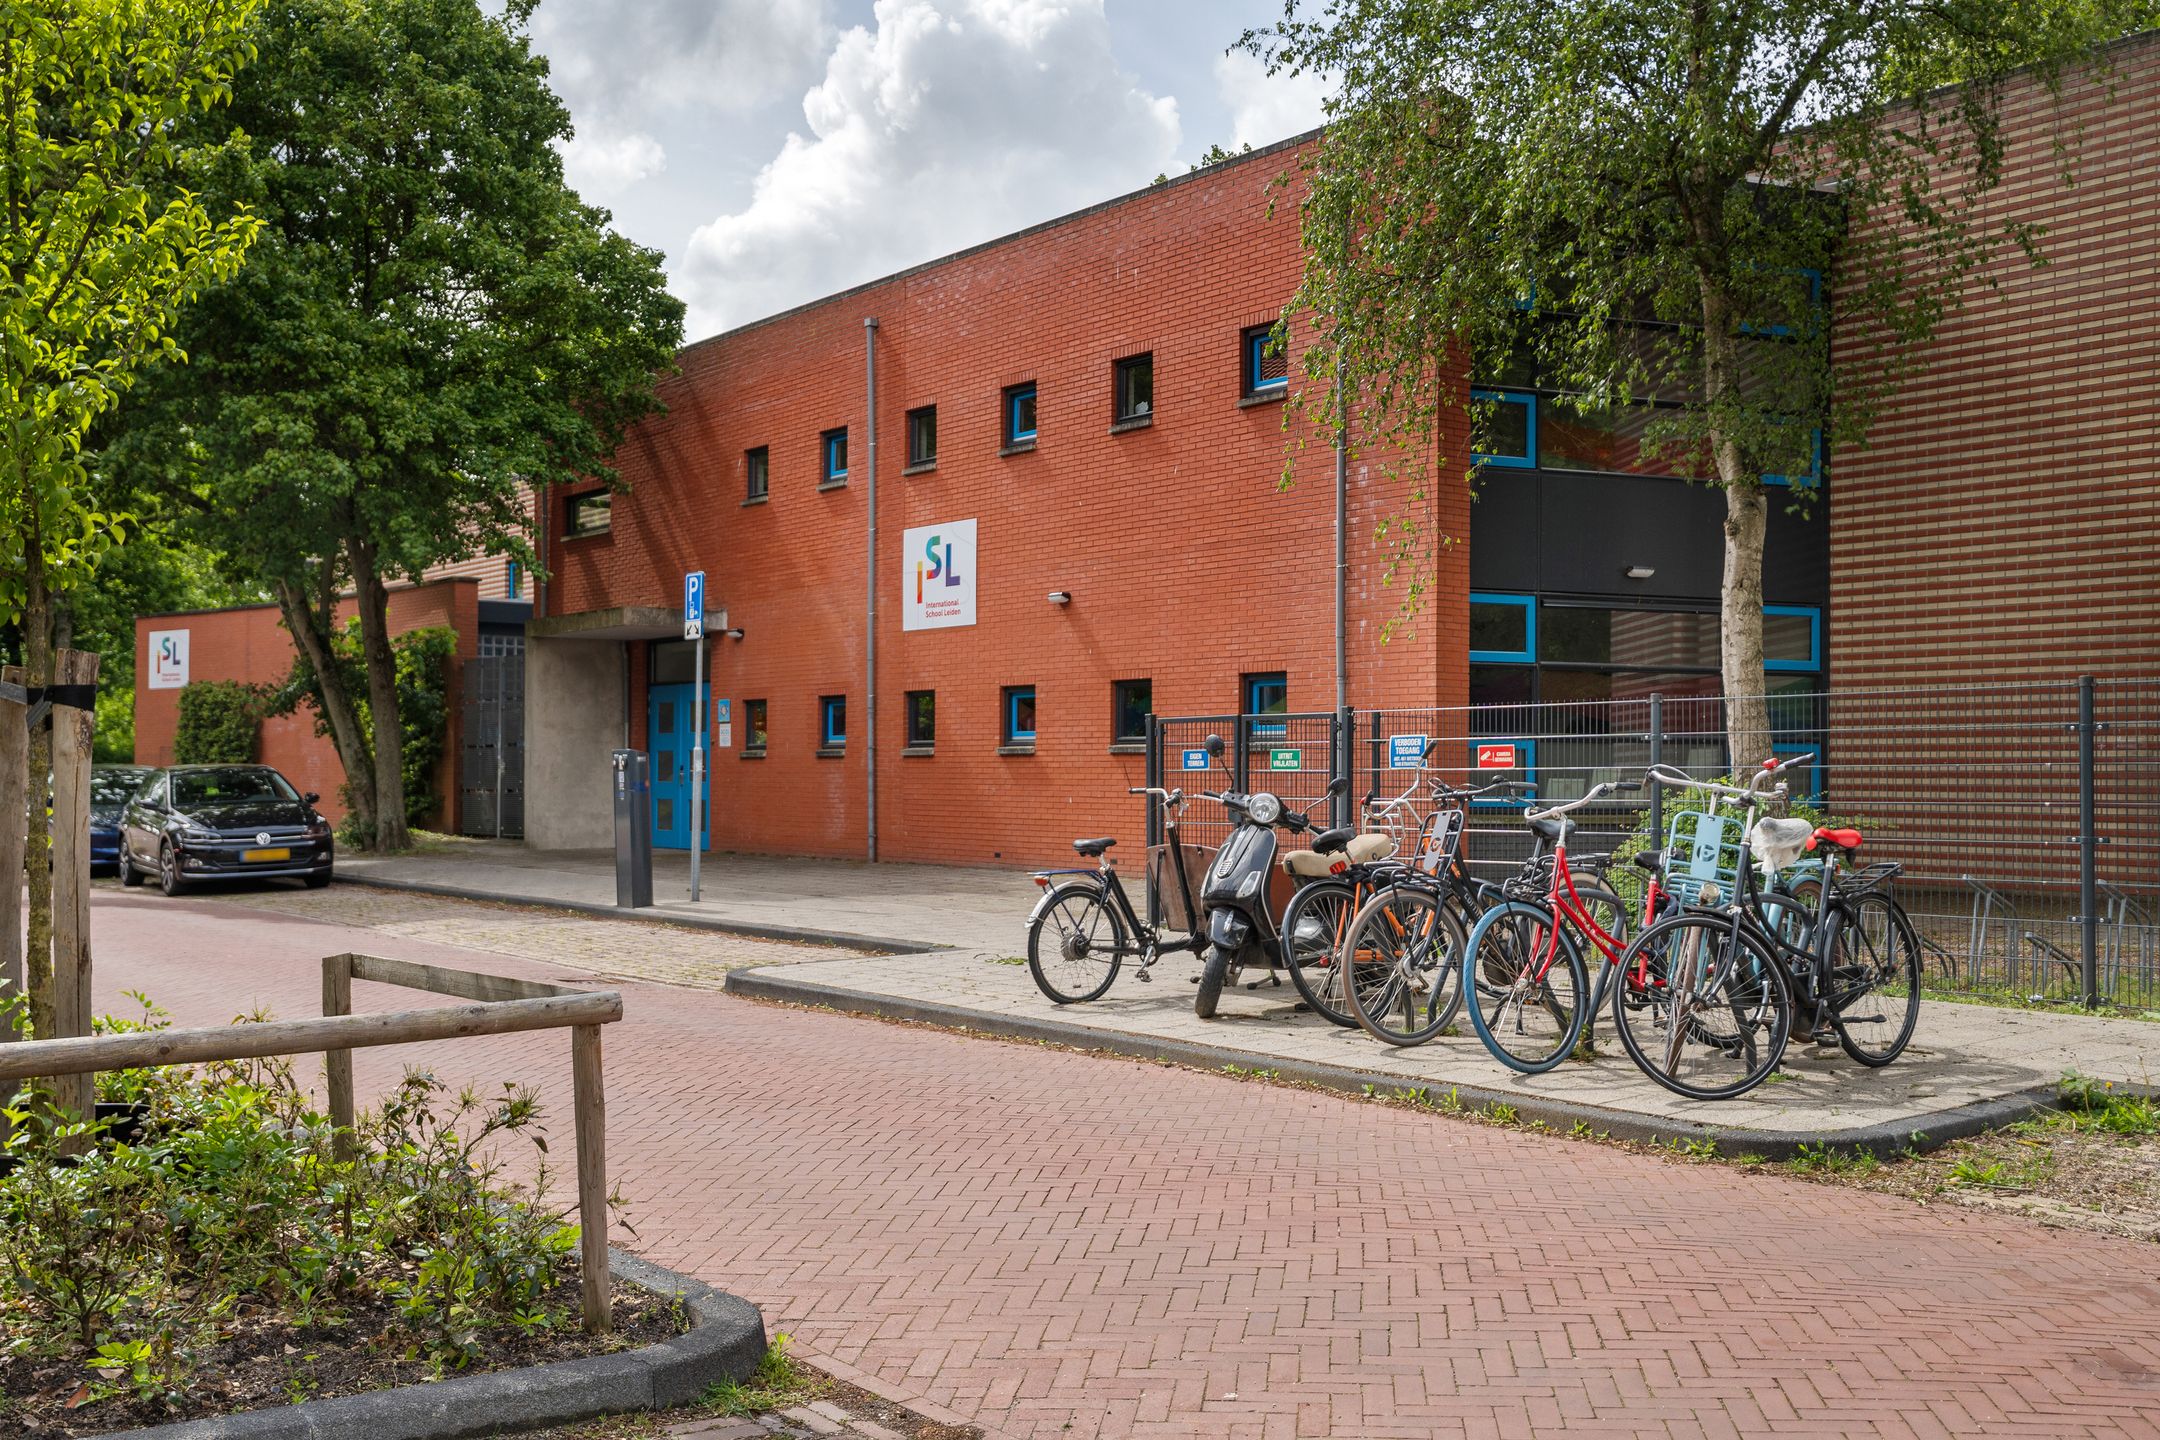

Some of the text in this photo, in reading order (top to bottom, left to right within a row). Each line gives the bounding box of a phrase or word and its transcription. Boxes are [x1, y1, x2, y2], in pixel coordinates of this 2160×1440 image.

[689, 577, 699, 601] P
[925, 599, 960, 608] International
[925, 610, 943, 618] School
[1394, 738, 1422, 747] VERBODEN
[1395, 746, 1420, 755] TOEGANG
